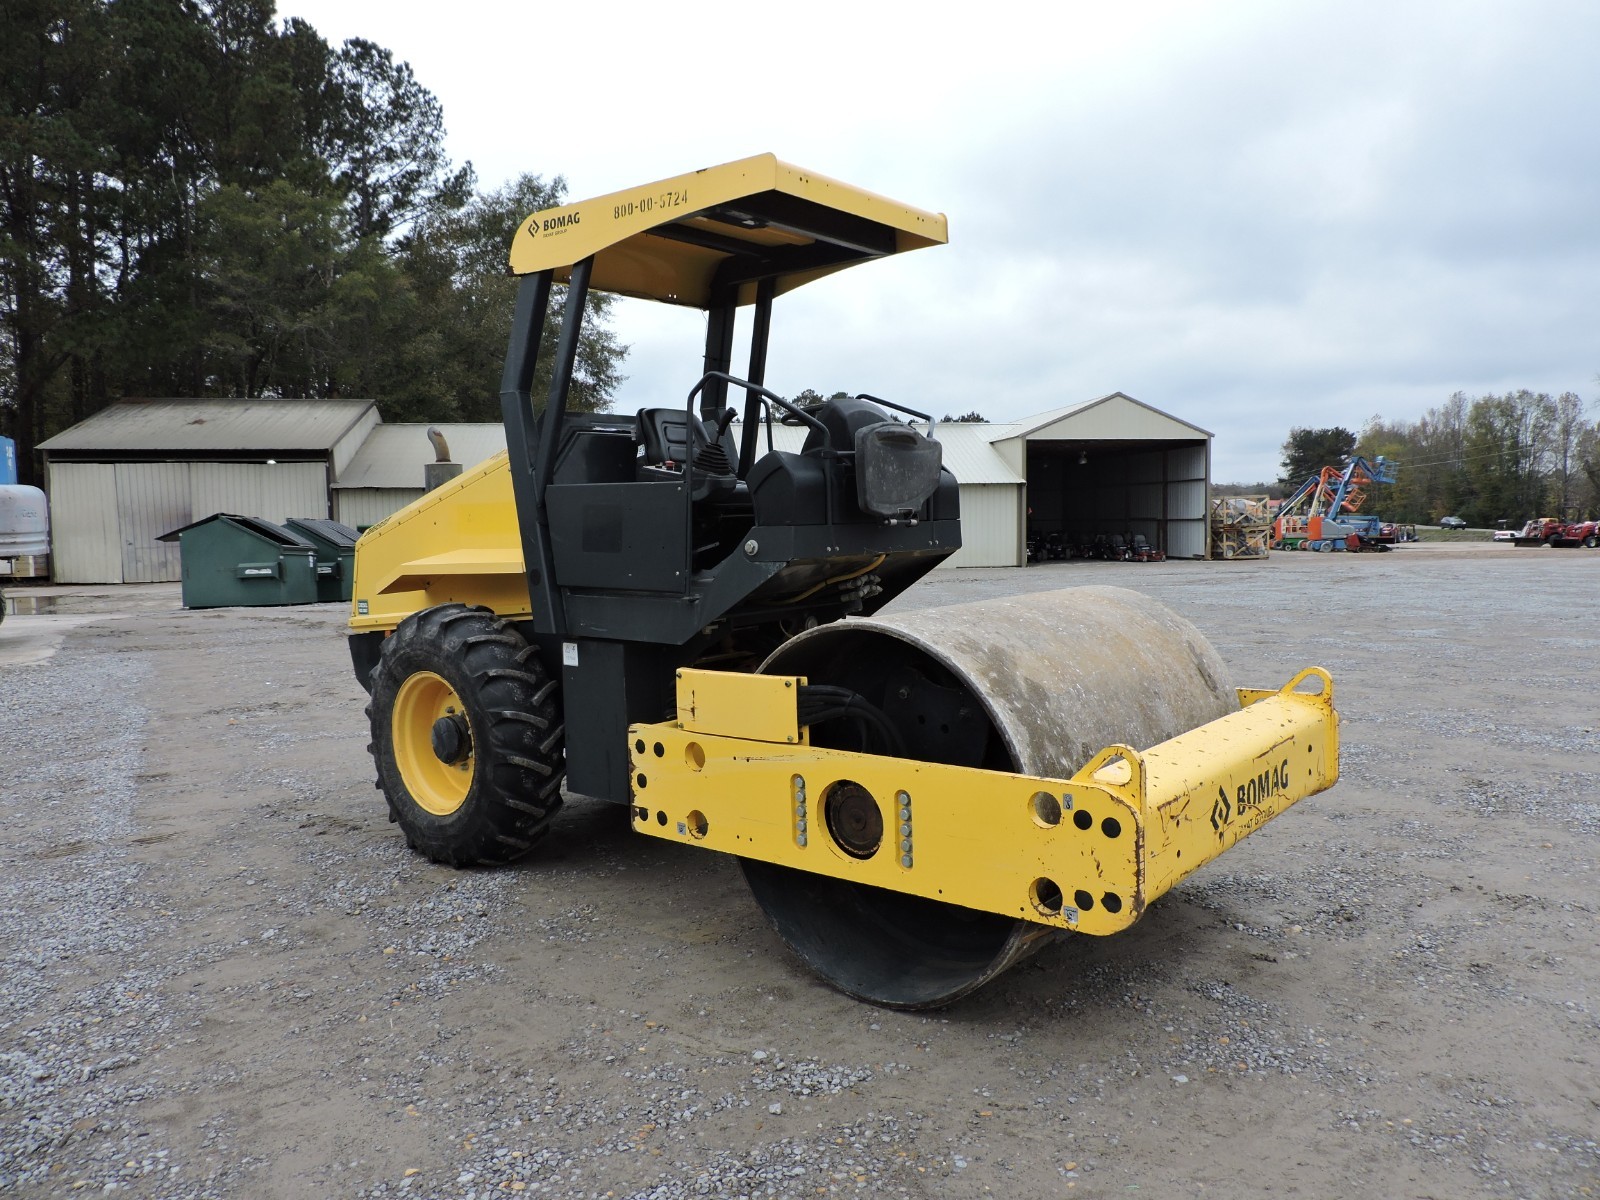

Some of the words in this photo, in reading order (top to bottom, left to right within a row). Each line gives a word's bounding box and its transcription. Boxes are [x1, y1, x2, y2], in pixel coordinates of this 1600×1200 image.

[614, 189, 687, 219] 800-00-5724
[543, 212, 580, 231] BOMAG
[1237, 759, 1288, 816] BOMAG
